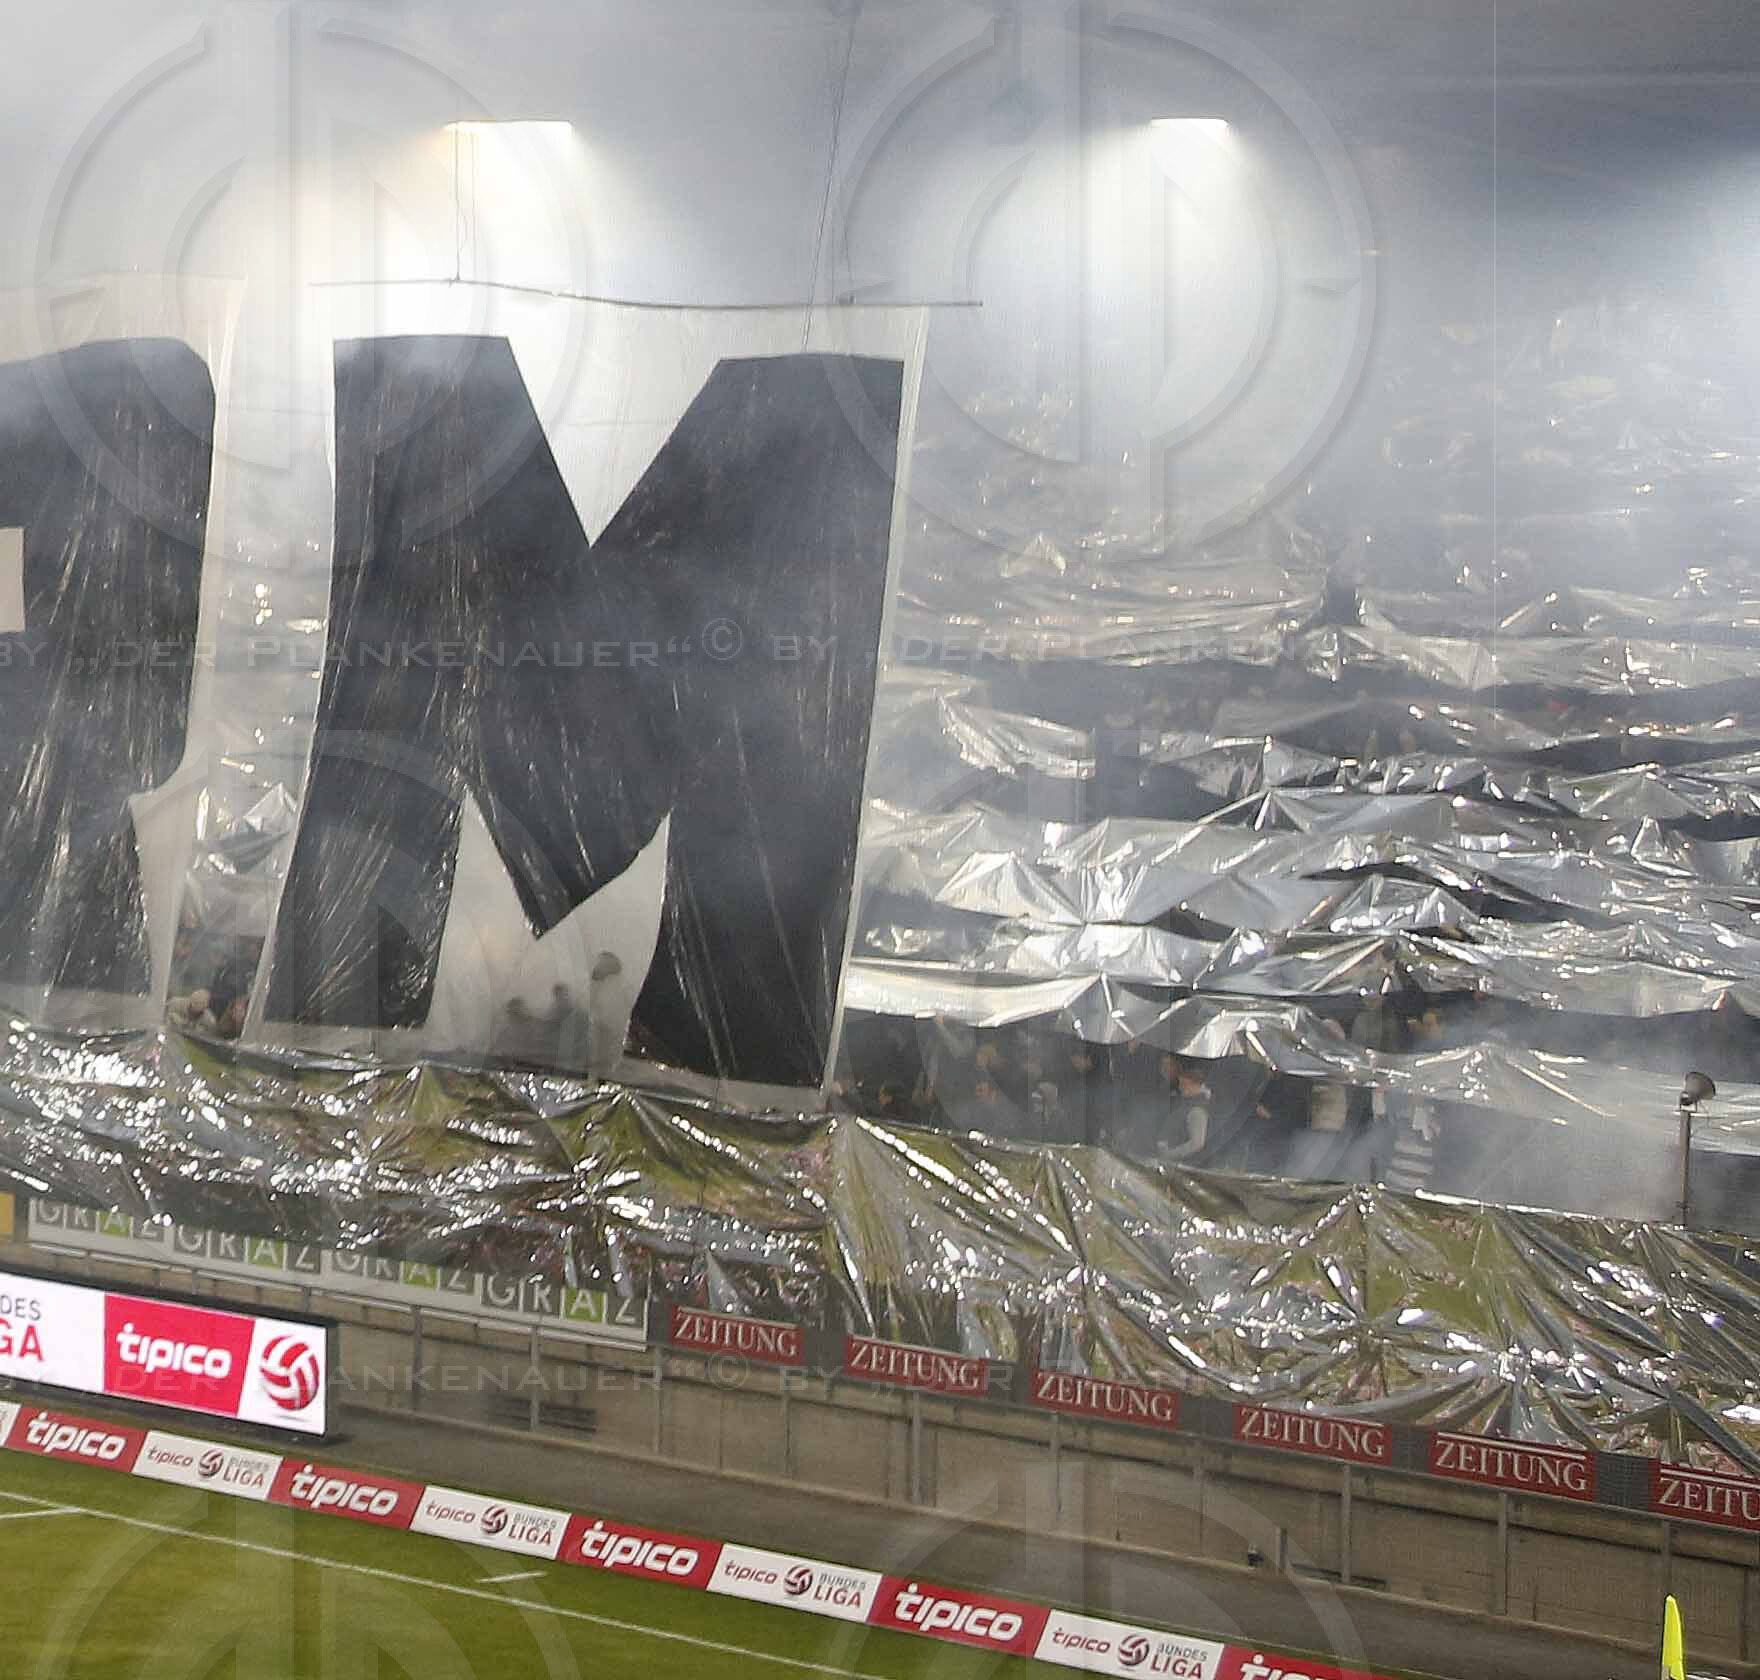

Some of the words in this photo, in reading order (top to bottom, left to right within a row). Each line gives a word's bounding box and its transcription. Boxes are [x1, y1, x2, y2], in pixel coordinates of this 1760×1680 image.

[117, 1322, 232, 1379] tipico
[673, 1312, 799, 1358] ZEITUNG
[850, 1340, 980, 1390] ZEITUNG
[1036, 1370, 1174, 1421] ZEITUNG
[25, 1410, 128, 1461] tipico
[1239, 1406, 1385, 1458] ZEITUNG
[145, 1445, 194, 1469] tipico
[222, 1465, 267, 1490] LIGA
[1434, 1439, 1588, 1492] ZEITUNG
[290, 1464, 400, 1517] tipico
[424, 1499, 477, 1524] tipico
[507, 1522, 553, 1547] LIGA
[580, 1521, 700, 1577] tipico
[723, 1559, 778, 1586] tipico
[812, 1584, 863, 1610] LIGA
[894, 1583, 1025, 1642] tipico
[1050, 1627, 1111, 1656] tipico
[1149, 1653, 1204, 1680] LIGA
